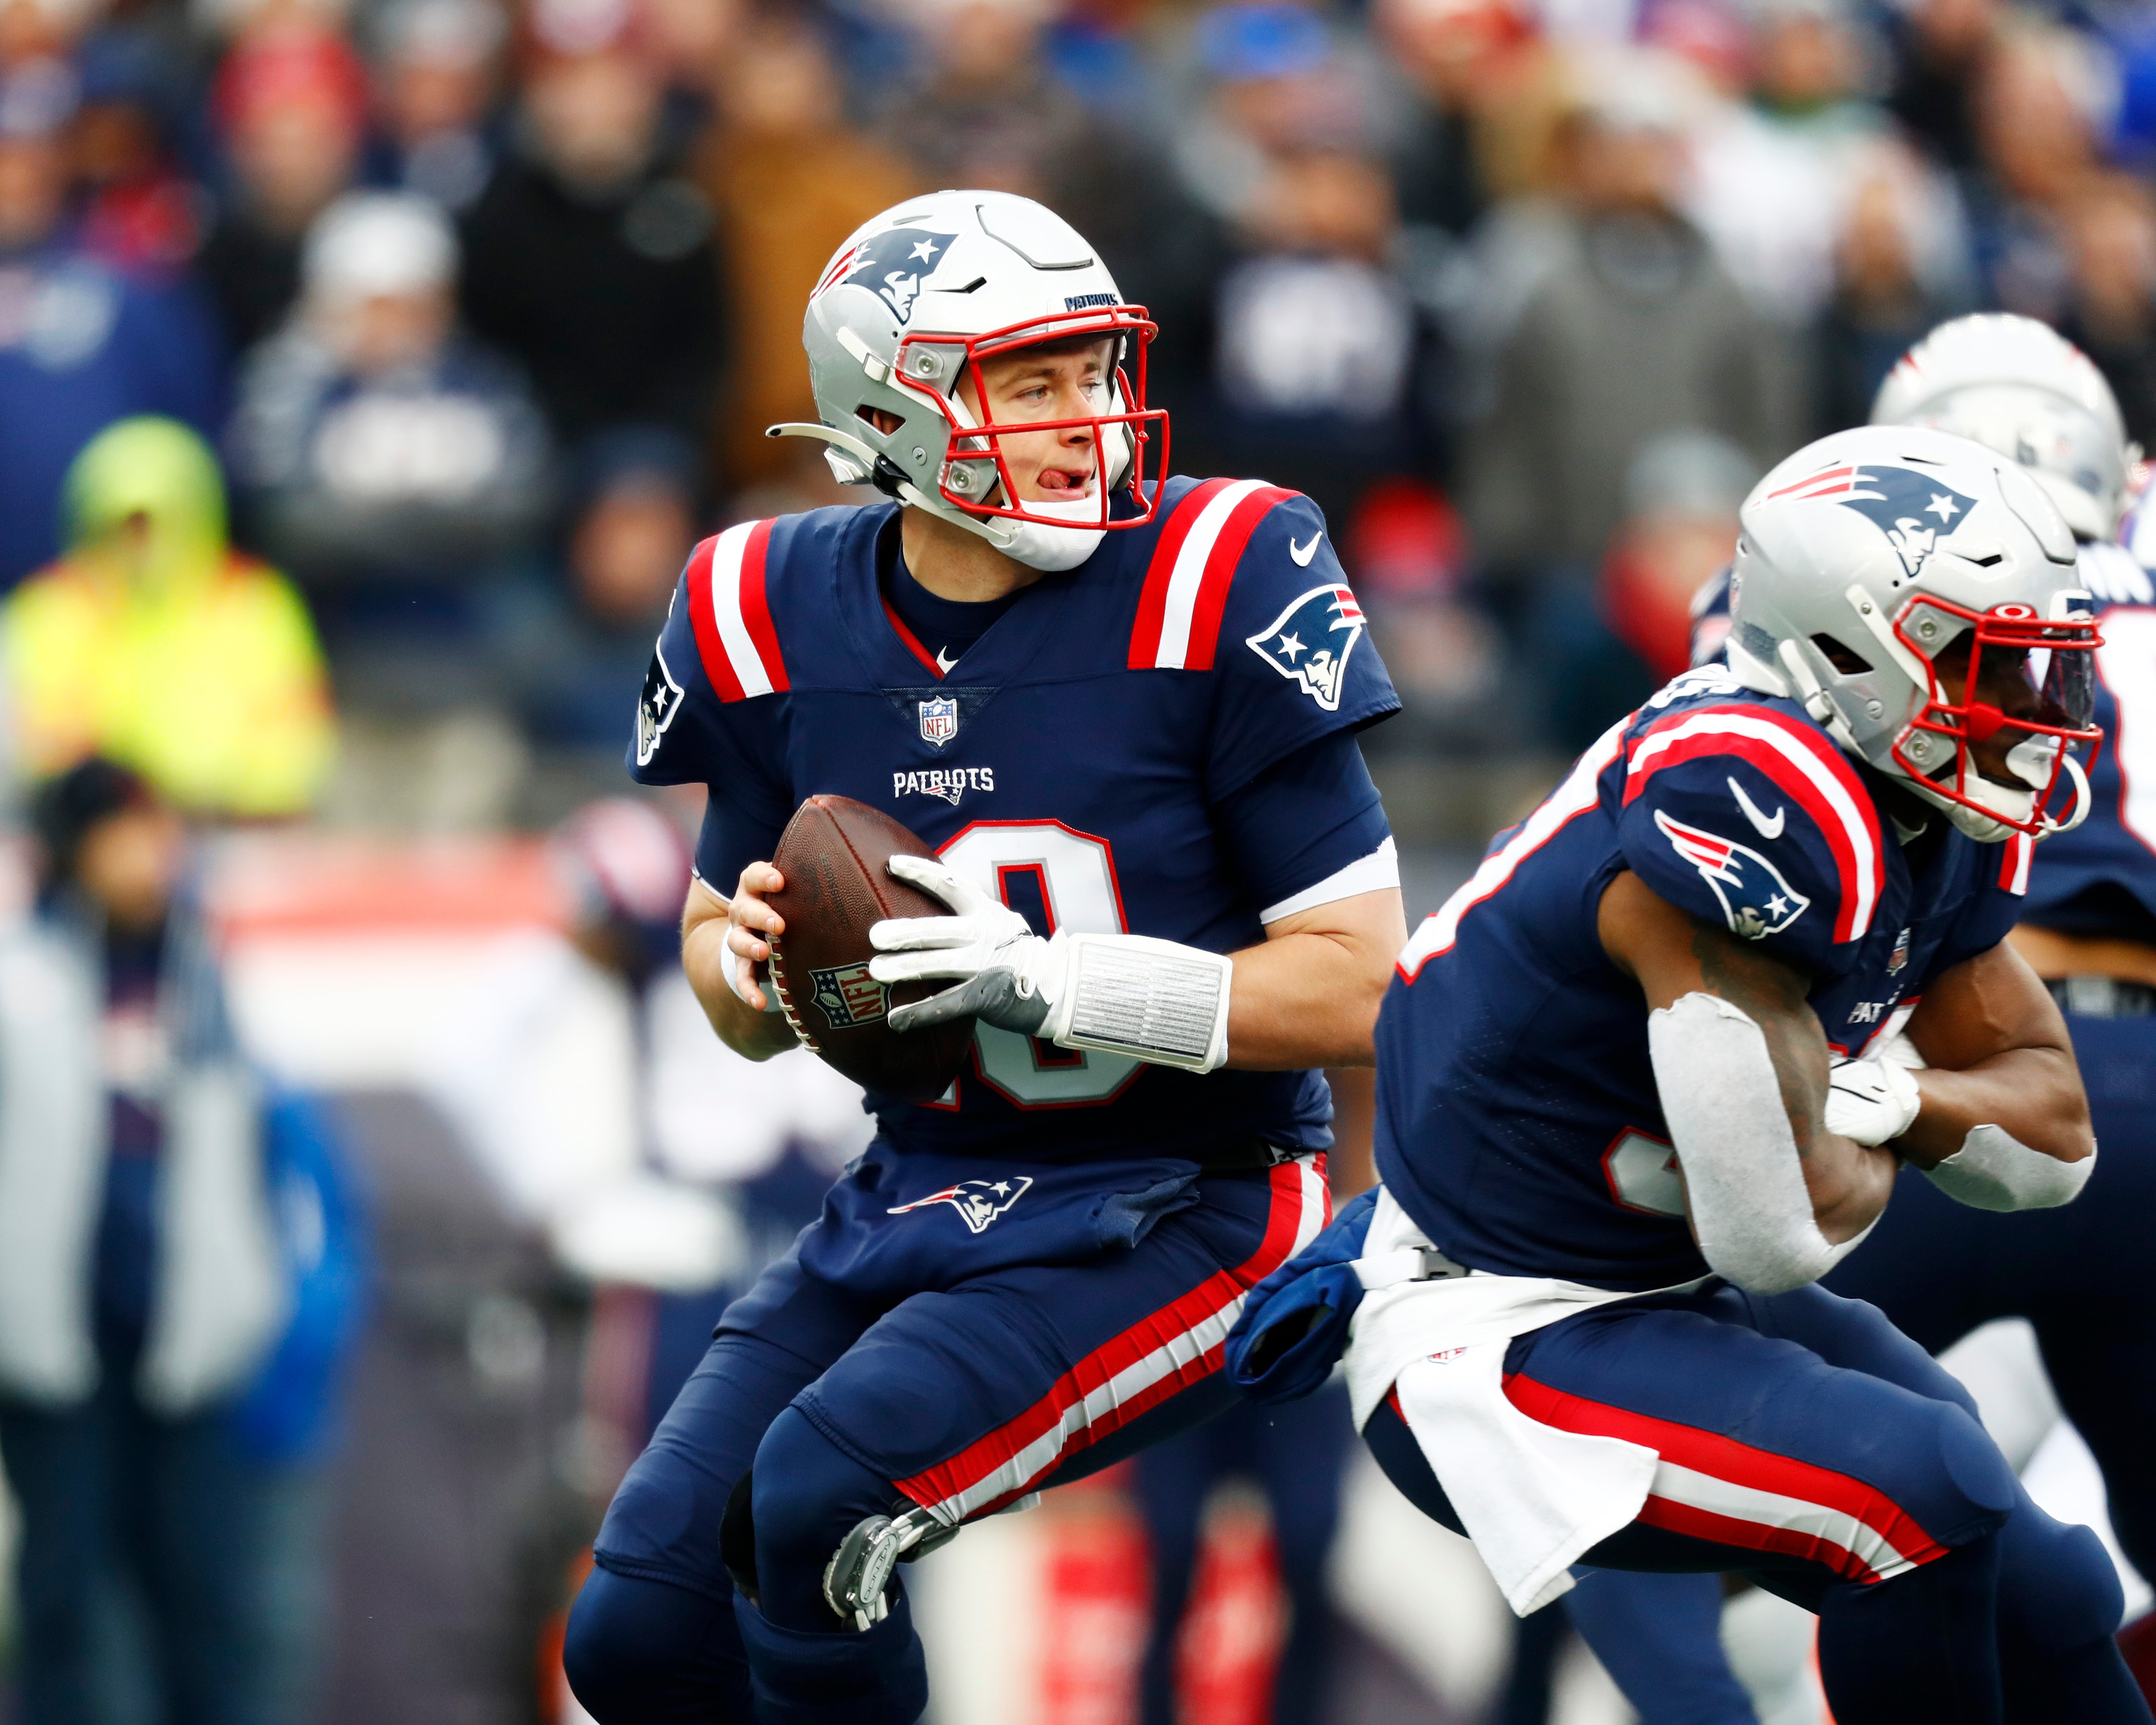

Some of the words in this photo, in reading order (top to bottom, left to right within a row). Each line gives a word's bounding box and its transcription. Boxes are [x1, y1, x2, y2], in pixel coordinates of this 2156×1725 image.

[1064, 293, 1119, 312] PATRIOTS
[925, 717, 951, 737] NFL
[893, 767, 994, 798] PATRIOTS
[840, 968, 883, 1020] NFL
